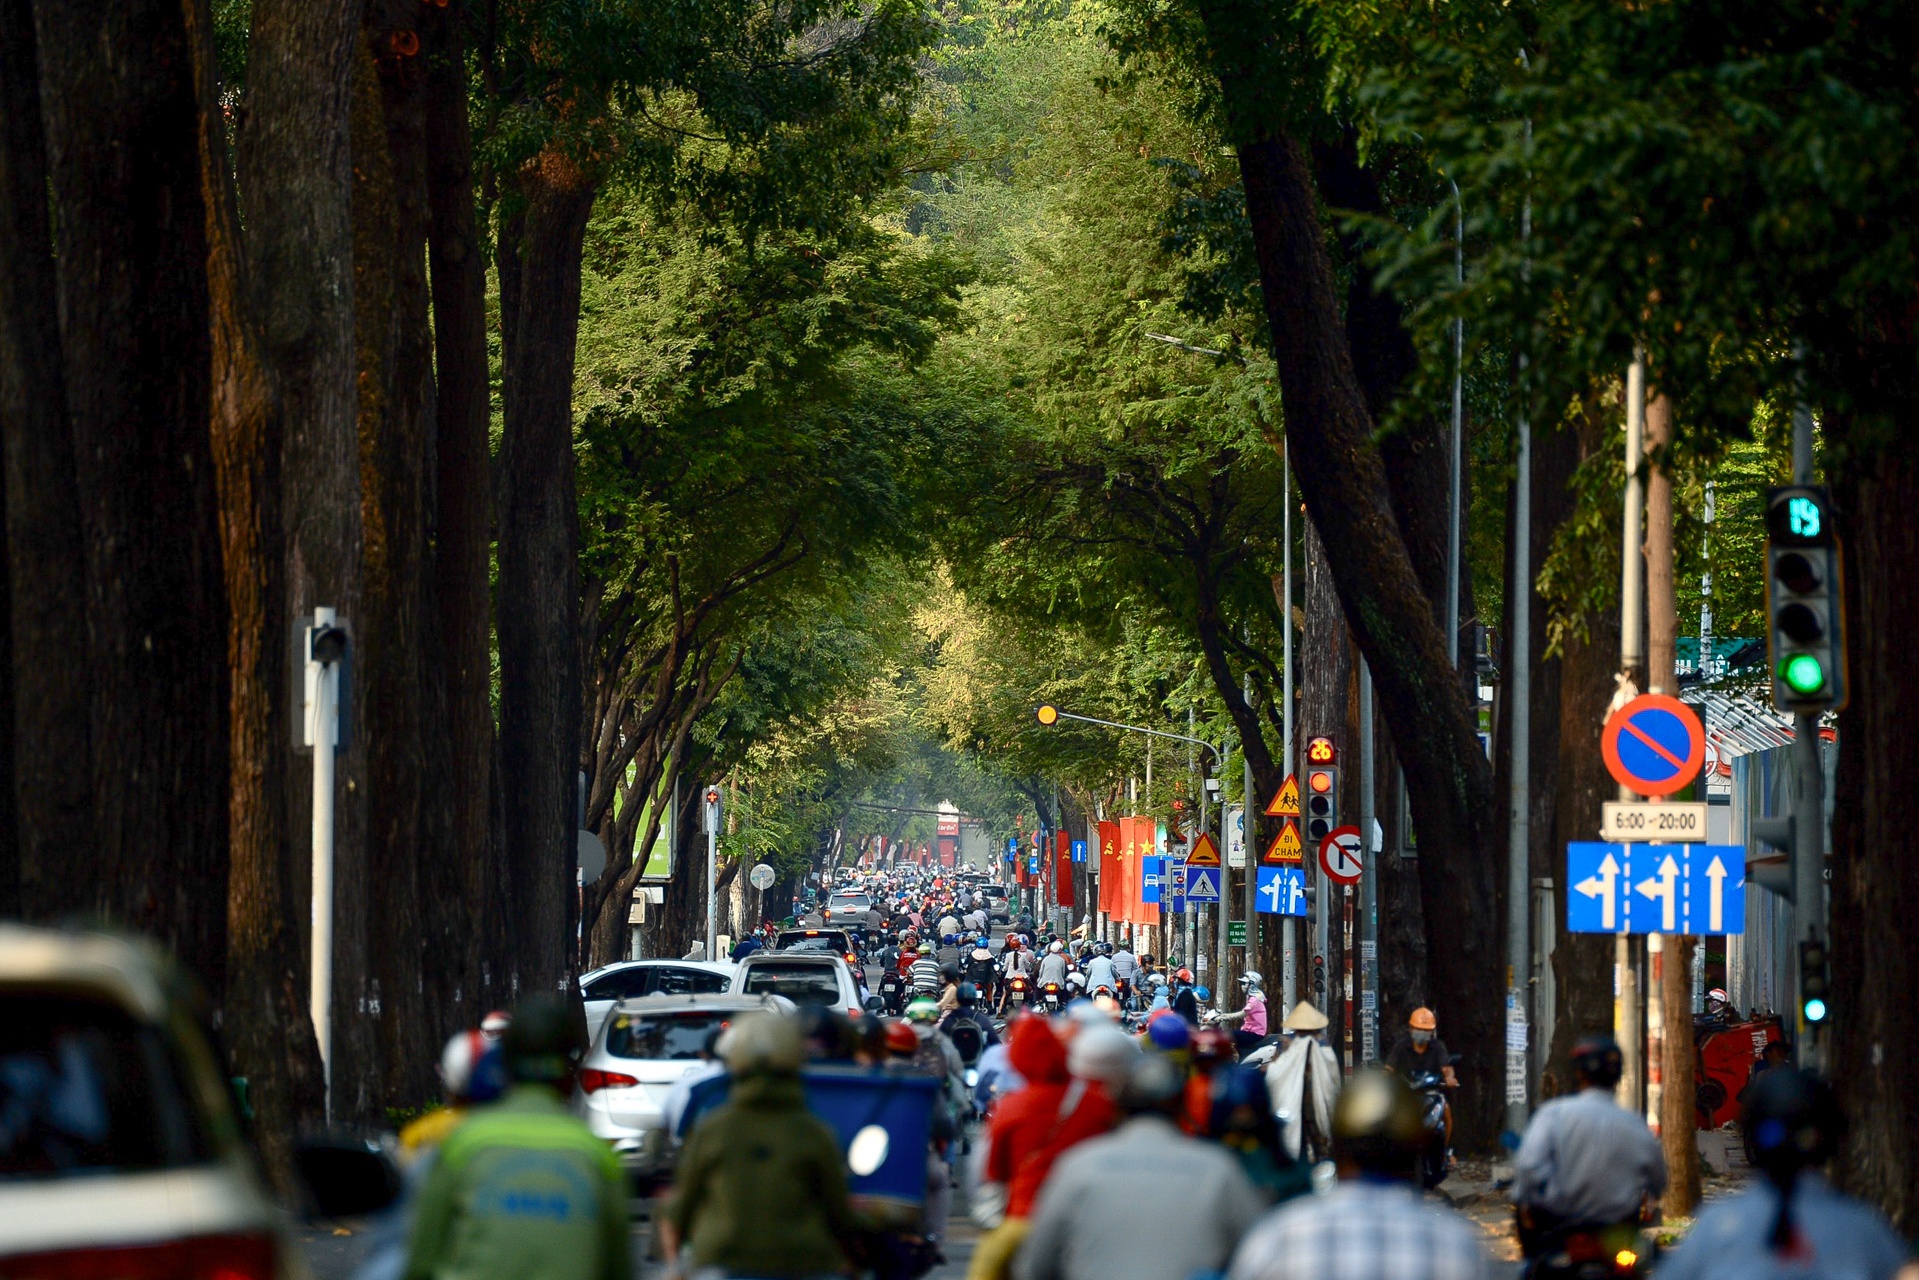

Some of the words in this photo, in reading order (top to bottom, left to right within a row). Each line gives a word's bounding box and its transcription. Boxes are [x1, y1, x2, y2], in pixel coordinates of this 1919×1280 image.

[1616, 812, 1645, 829] 6:00
[1659, 813, 1696, 829] 20:00
[1284, 835, 1293, 843] ĐI
